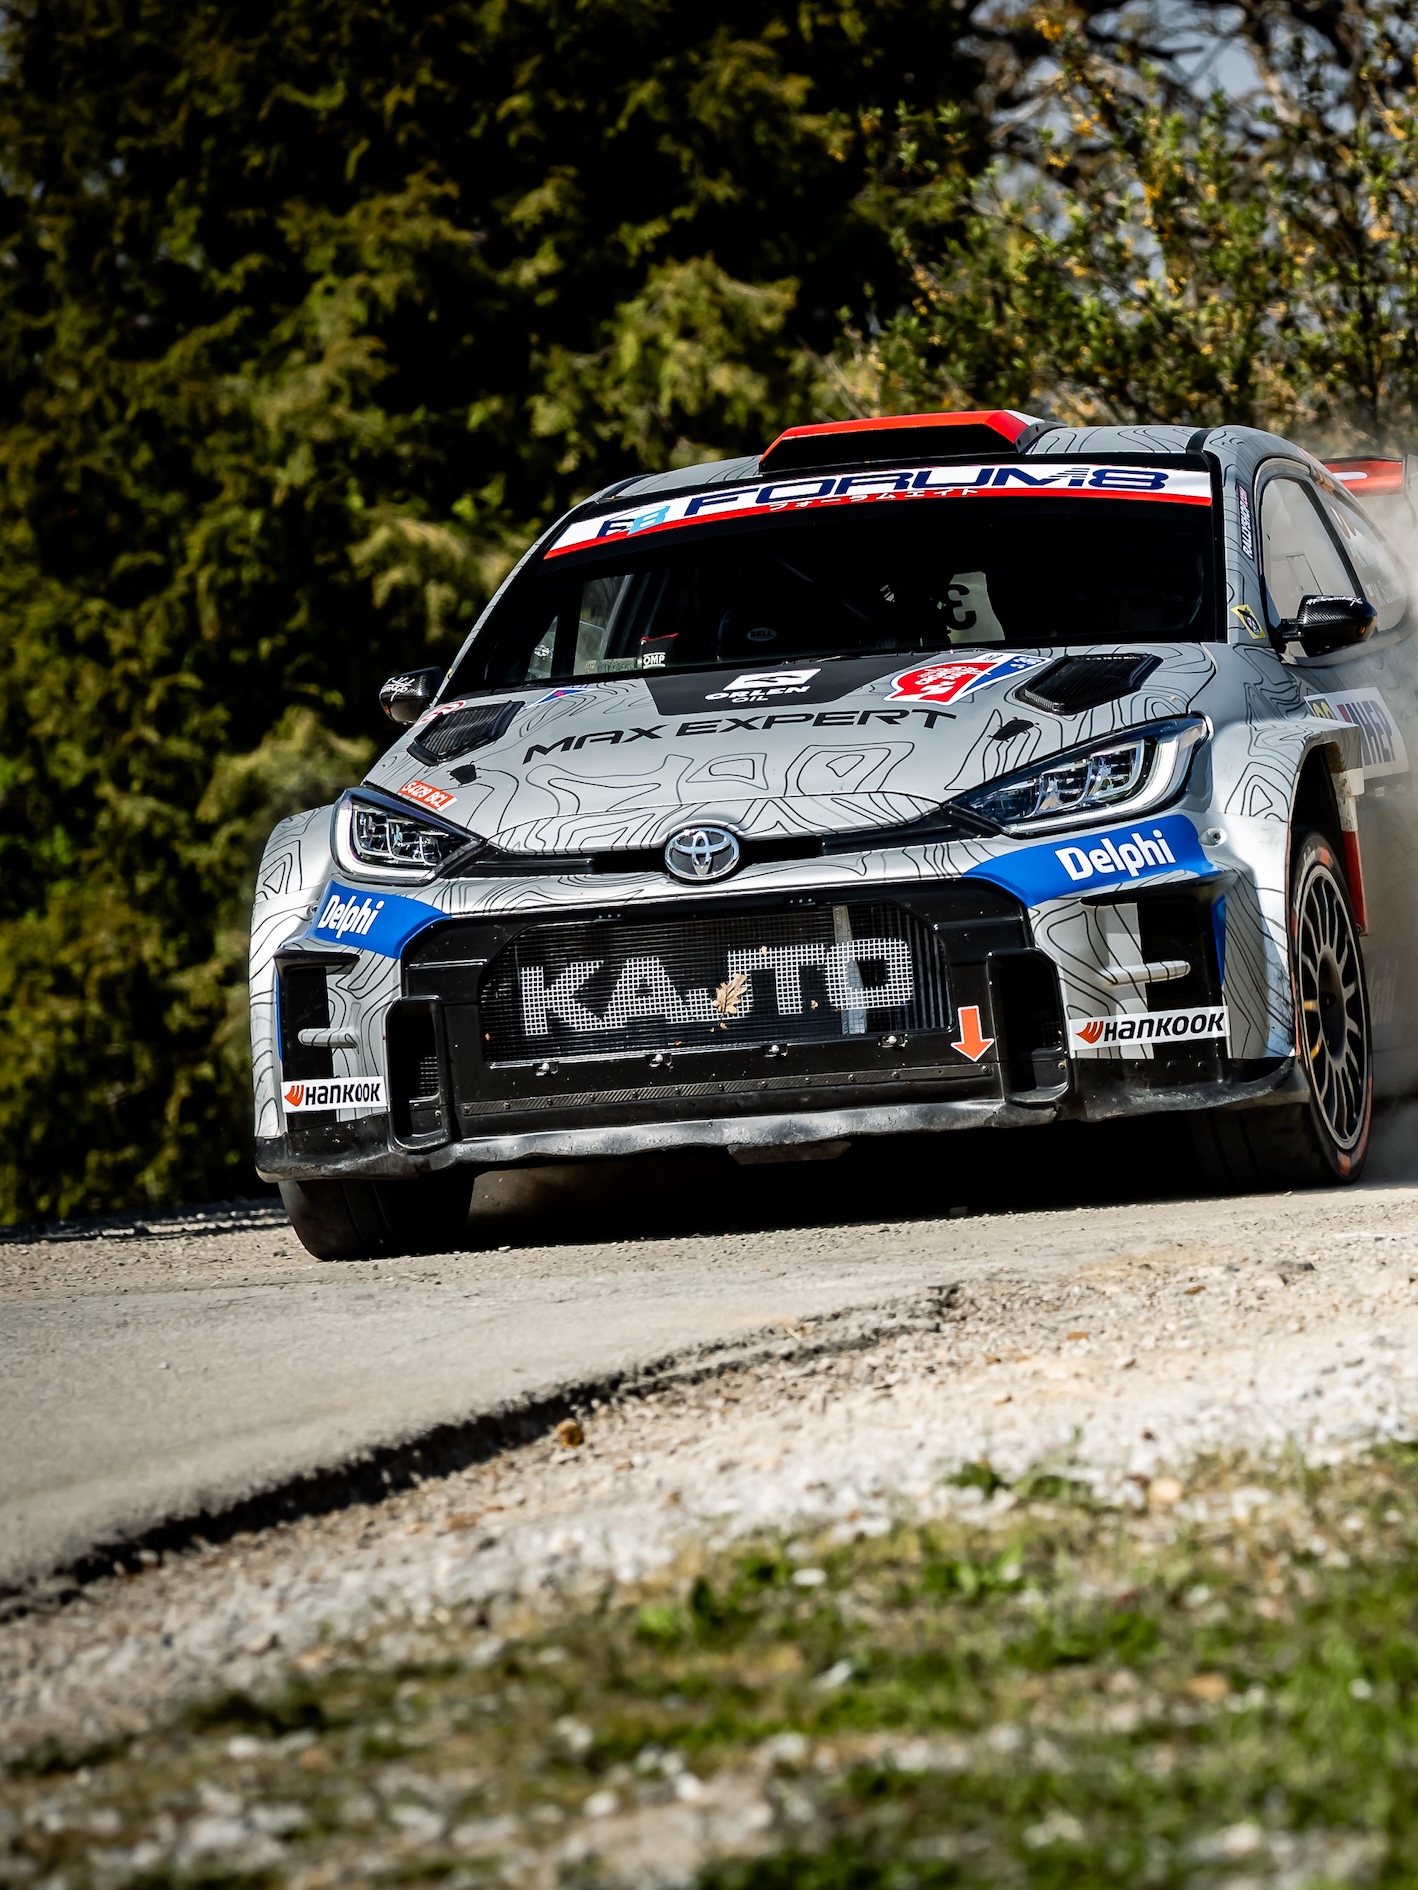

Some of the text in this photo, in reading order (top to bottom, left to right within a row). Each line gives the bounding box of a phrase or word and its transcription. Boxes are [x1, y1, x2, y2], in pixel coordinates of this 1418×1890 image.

[643, 654, 666, 667] OMP
[704, 684, 810, 702] ORLEN
[731, 692, 769, 704] OIL
[522, 708, 957, 766] MAX EXPERT
[1055, 828, 1177, 881] Delphi
[317, 895, 384, 939] Delphi
